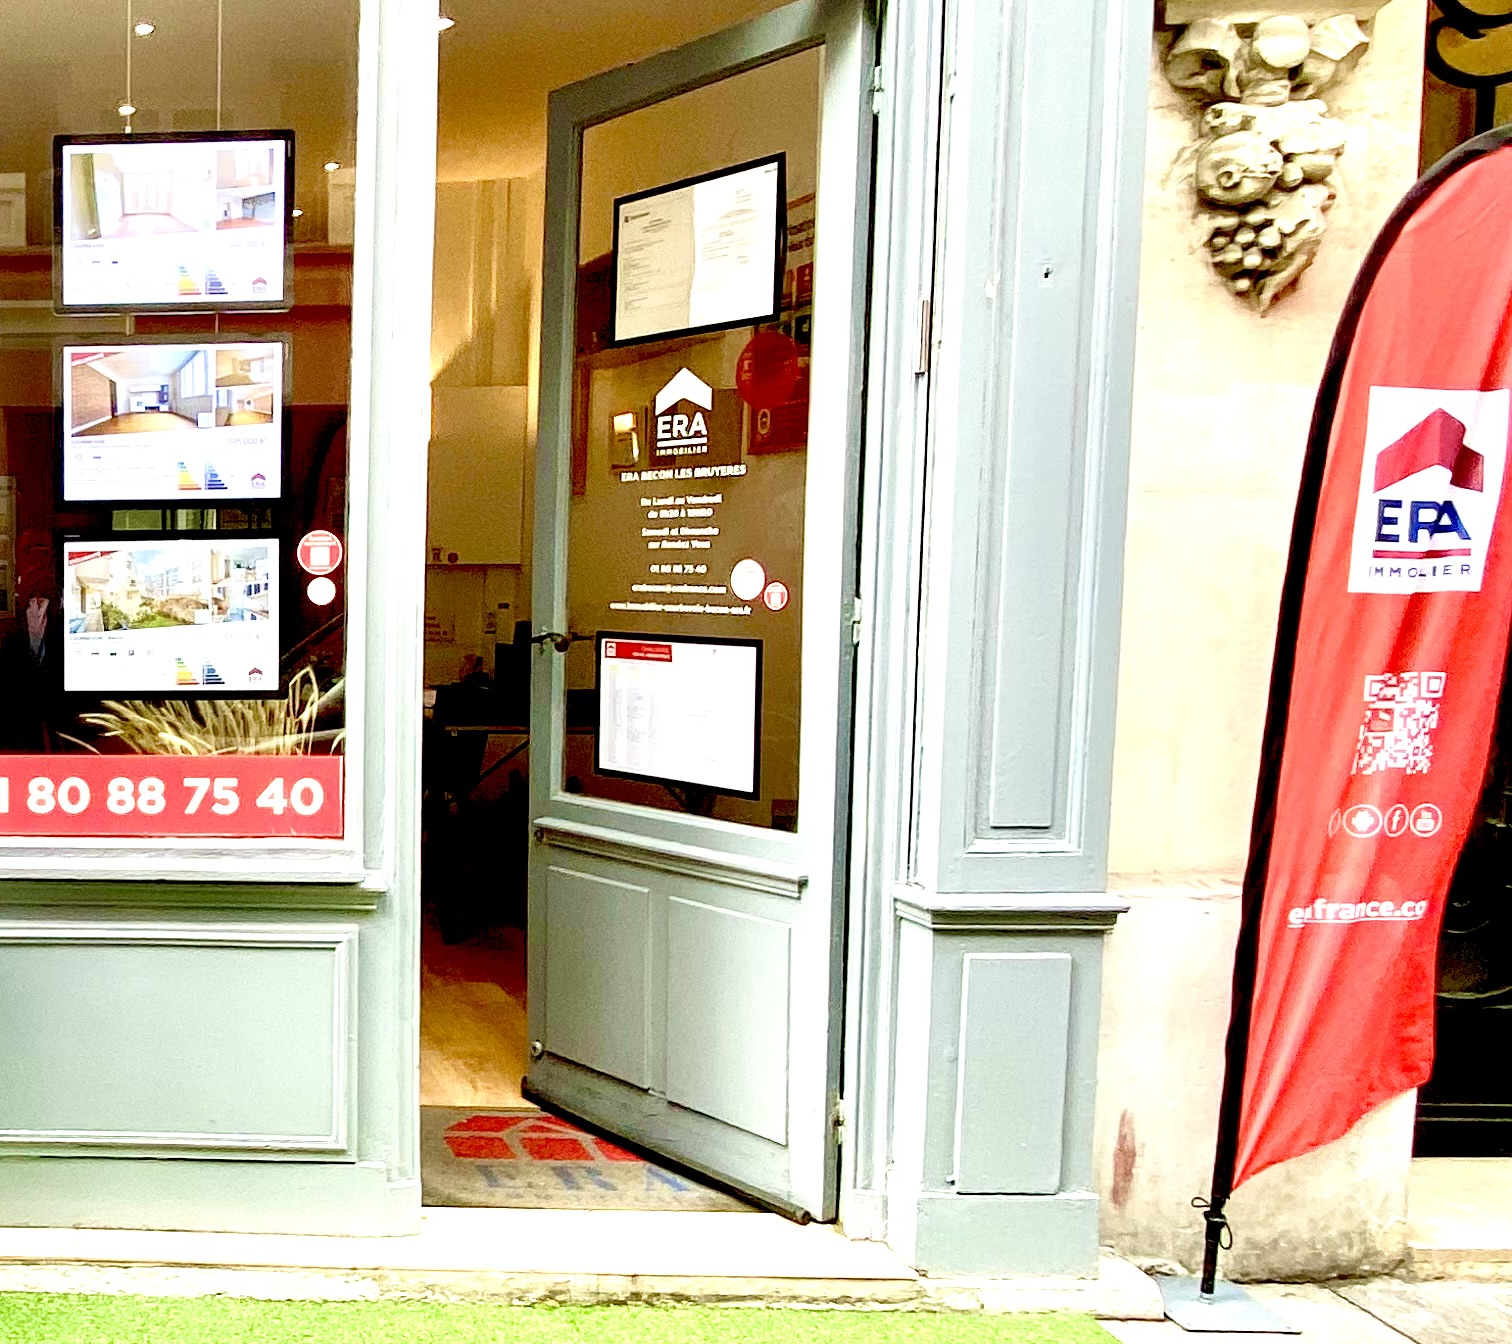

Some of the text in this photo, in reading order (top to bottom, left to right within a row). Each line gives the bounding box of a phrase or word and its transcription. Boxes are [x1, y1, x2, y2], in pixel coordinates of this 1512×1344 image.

[657, 411, 708, 438] ERA
[621, 472, 639, 482] ERA
[675, 467, 692, 478] LES
[1375, 499, 1472, 543] ERA
[26, 776, 91, 815] 80
[107, 776, 166, 815] 88
[183, 777, 239, 815] 75
[255, 776, 324, 816] 40
